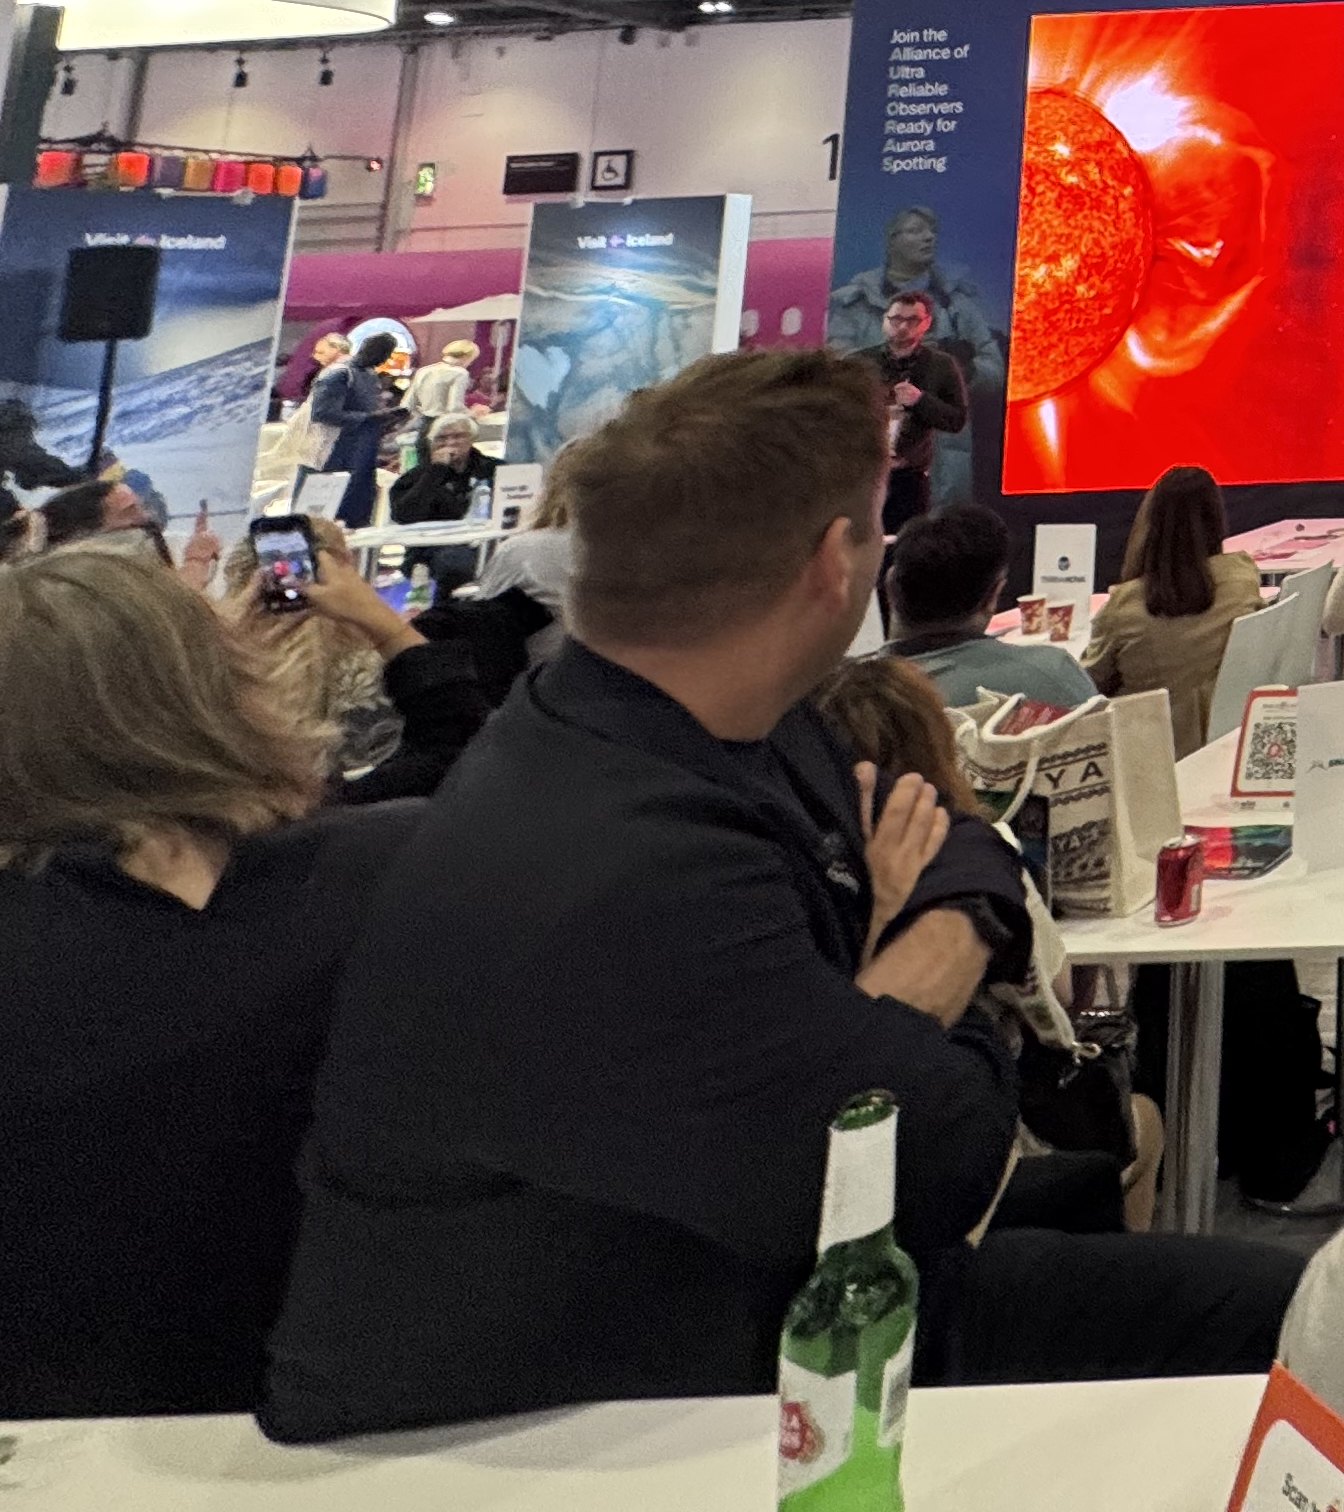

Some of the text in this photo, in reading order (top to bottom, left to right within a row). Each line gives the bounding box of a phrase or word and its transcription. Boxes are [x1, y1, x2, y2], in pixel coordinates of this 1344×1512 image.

[890, 27, 949, 44] Join the
[888, 43, 971, 62] Alliance of
[888, 64, 926, 80] Ultra
[887, 81, 949, 99] Reliable
[886, 101, 964, 117] Observers
[883, 117, 958, 137] Ready for
[881, 138, 936, 154] Aurora
[881, 155, 948, 174] Spotting
[577, 232, 675, 249] Visit Iceland
